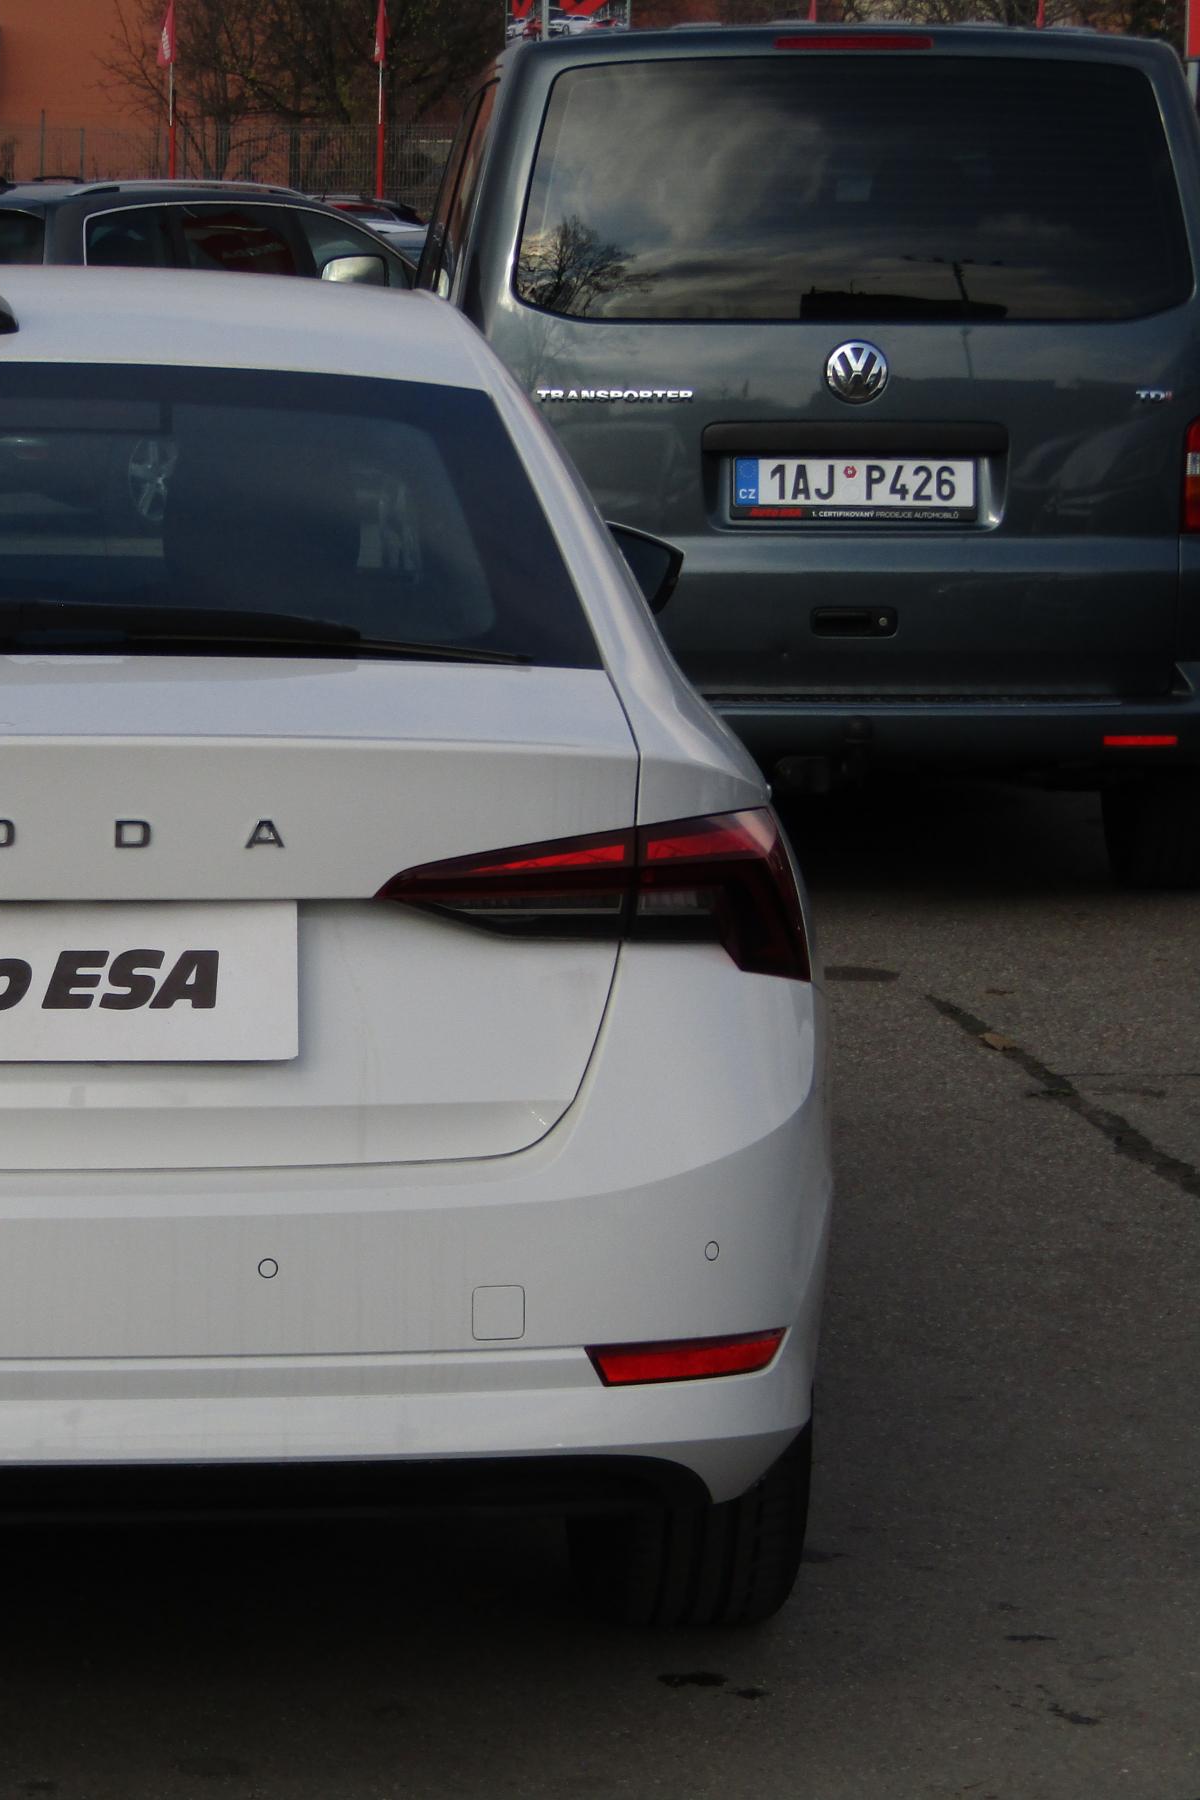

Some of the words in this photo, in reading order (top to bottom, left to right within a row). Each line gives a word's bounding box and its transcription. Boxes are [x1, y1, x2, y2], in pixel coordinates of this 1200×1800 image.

[537, 389, 694, 404] TRANSPORTER
[770, 464, 835, 500] 1AJ
[865, 465, 956, 501] P426
[739, 488, 756, 499] CZ
[875, 511, 913, 519] PRODEJCE
[41, 949, 219, 1010] ESA
